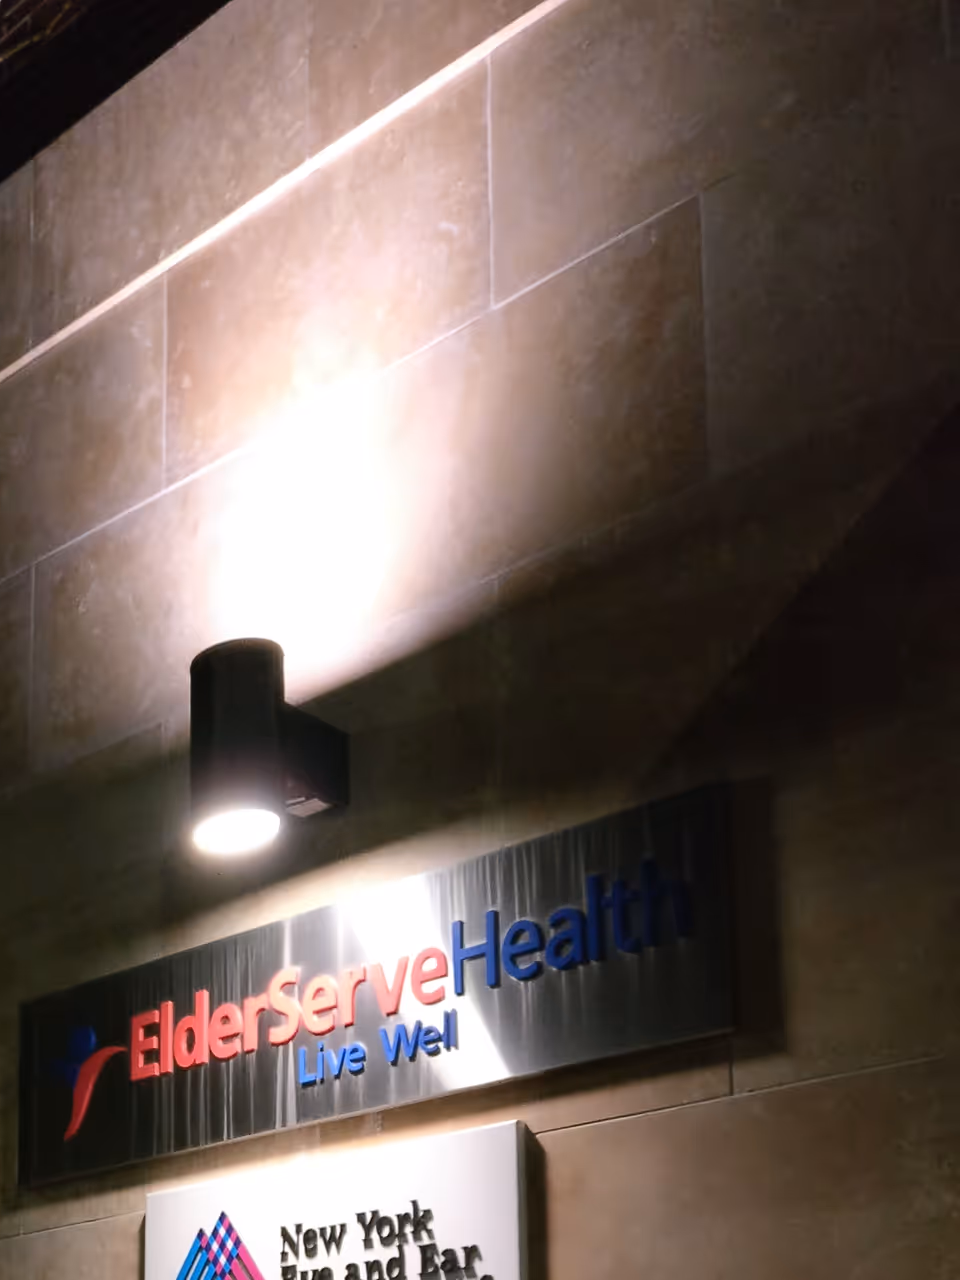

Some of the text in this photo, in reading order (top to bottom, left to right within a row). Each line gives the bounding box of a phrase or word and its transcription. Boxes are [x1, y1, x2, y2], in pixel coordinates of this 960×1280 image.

[298, 1009, 459, 1087] Live Well
[281, 1200, 434, 1258] New York
[419, 1241, 482, 1280] Ear
